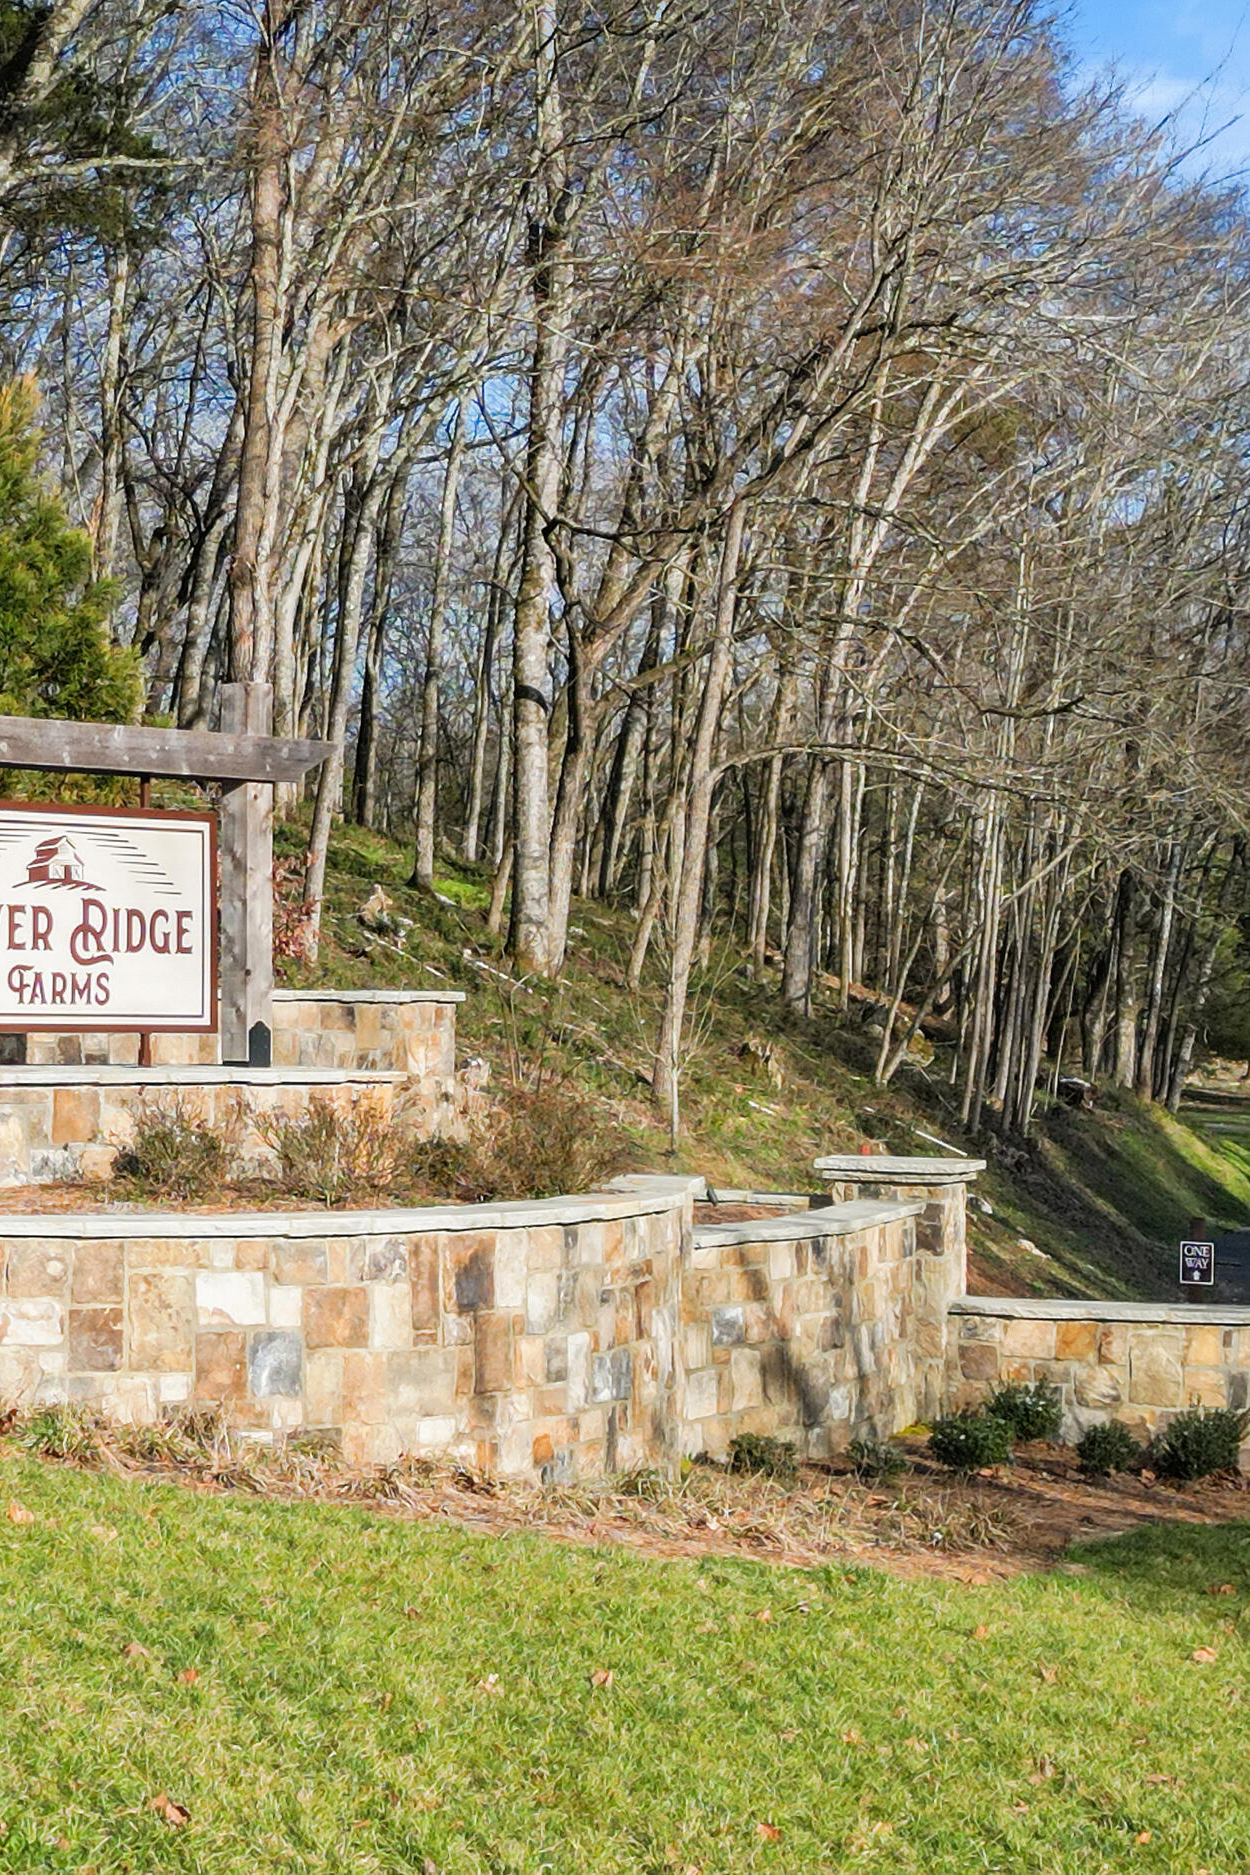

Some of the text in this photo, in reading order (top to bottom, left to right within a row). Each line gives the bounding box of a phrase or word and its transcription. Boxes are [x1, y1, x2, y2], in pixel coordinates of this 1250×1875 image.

[70, 898, 194, 966] RIDGE
[7, 964, 111, 1006] FARMS
[1184, 1245, 1210, 1257] ONE
[1184, 1257, 1209, 1269] WAY
